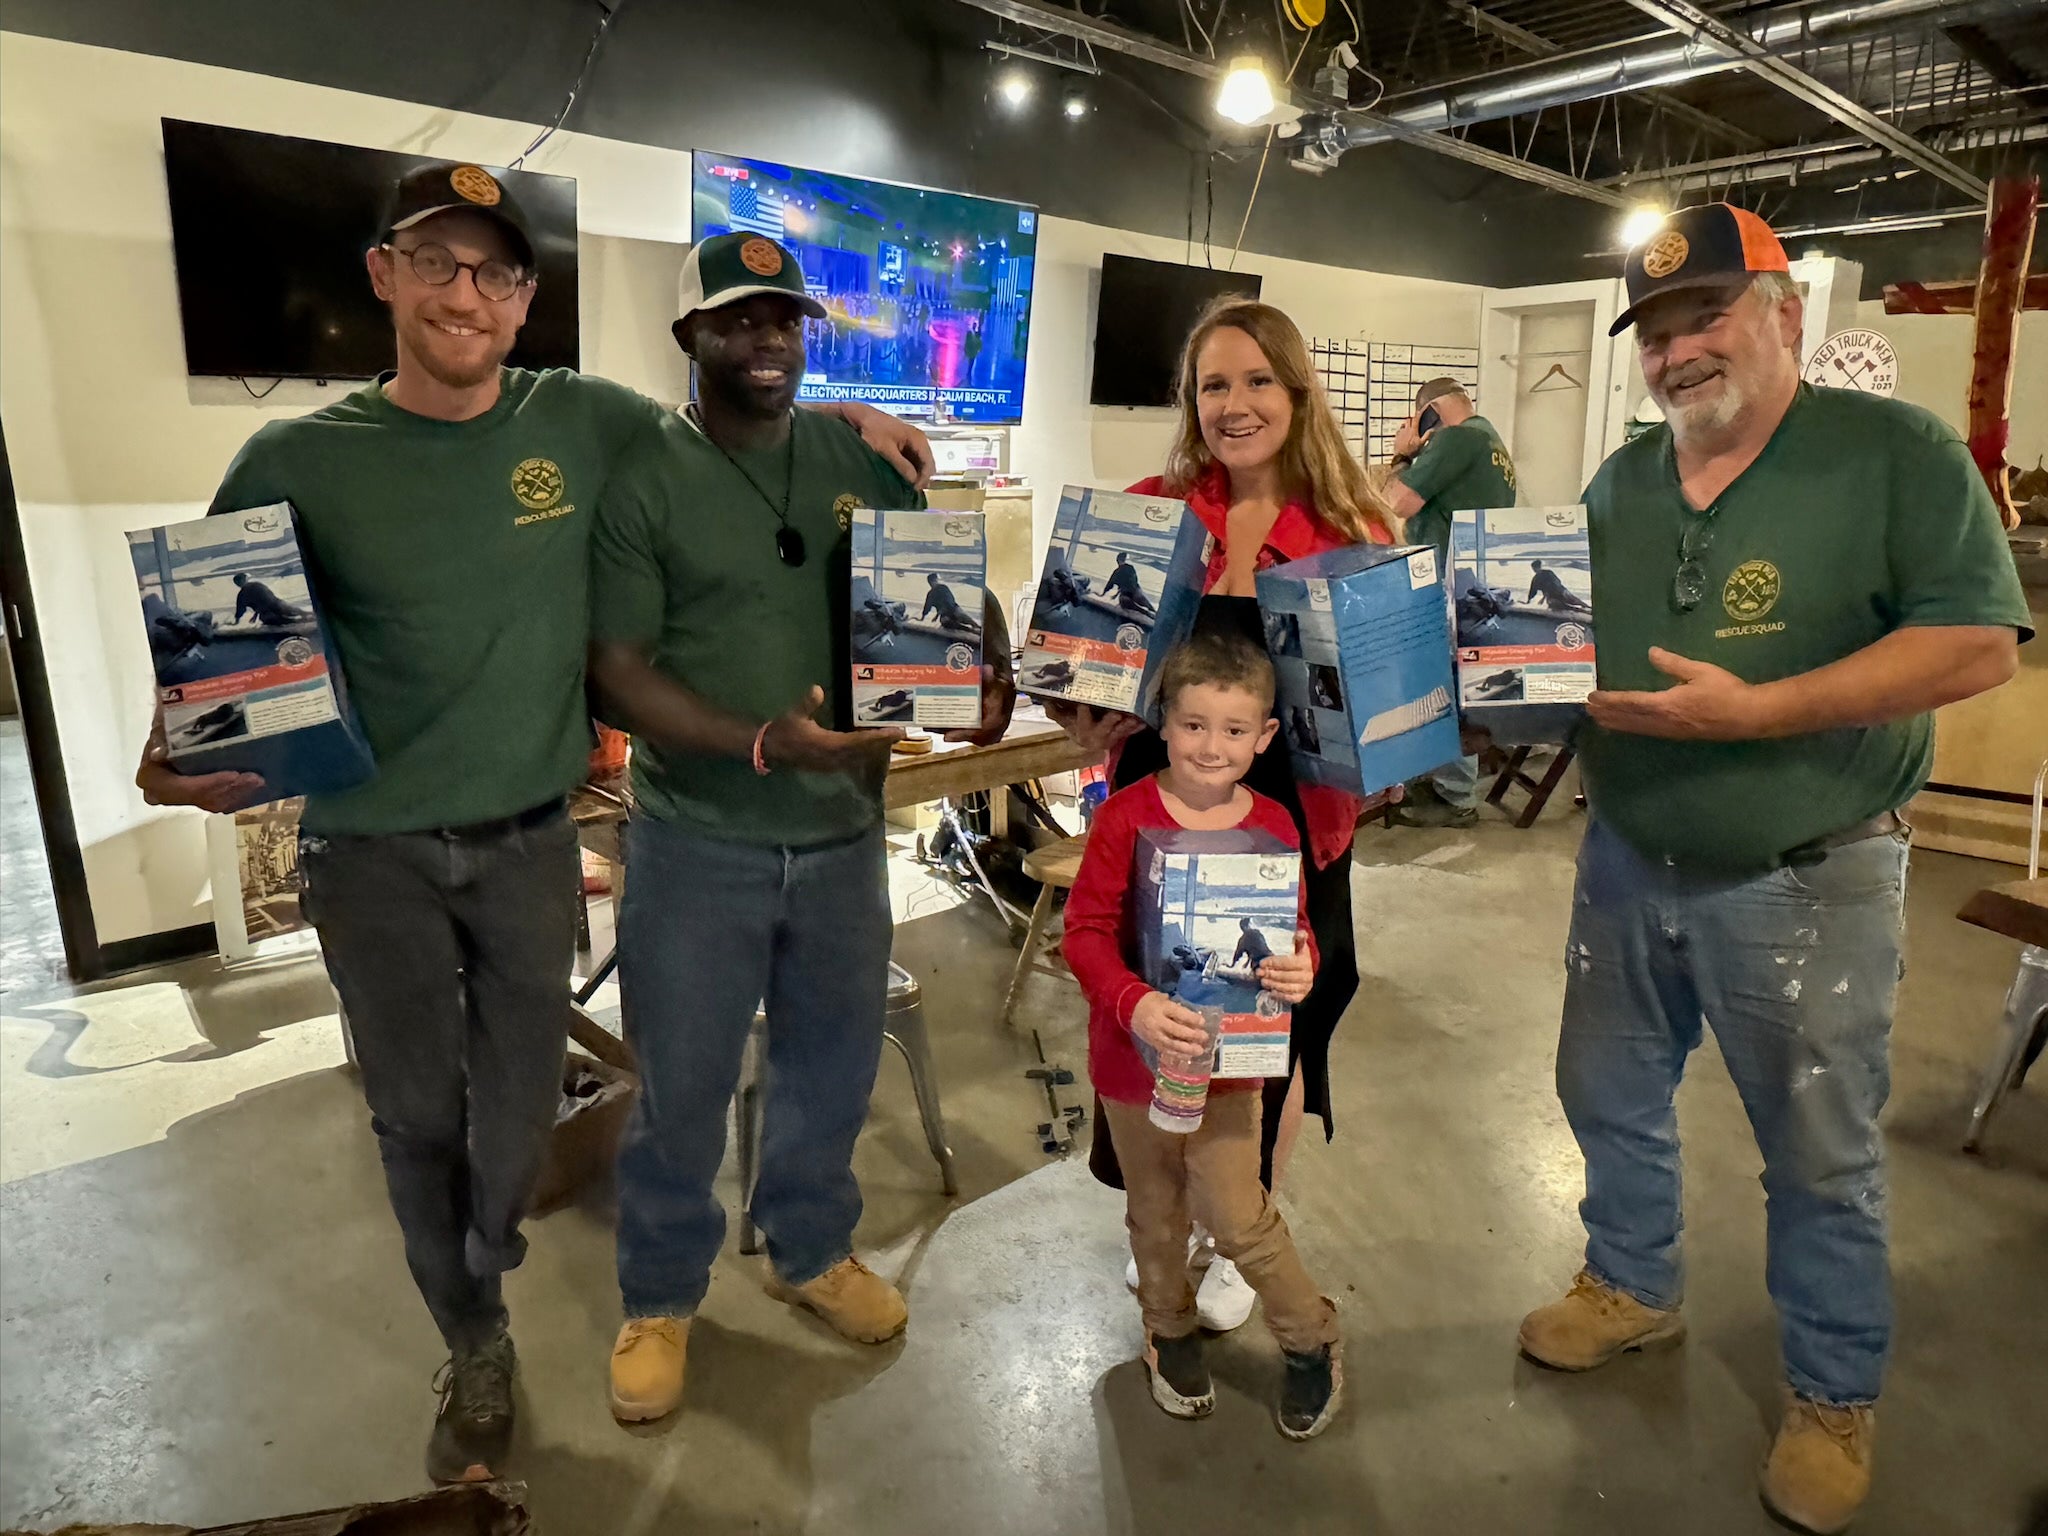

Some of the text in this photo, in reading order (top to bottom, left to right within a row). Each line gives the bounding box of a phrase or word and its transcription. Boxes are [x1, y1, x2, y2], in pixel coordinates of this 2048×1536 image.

[1814, 333, 1894, 367] RED TRUCK MEN
[800, 384, 850, 399] ELECTION
[850, 387, 928, 401] HEADQUARTERS
[964, 392, 997, 405] BEACH,
[998, 394, 1007, 404] FL
[548, 504, 576, 518] SQUAD
[1715, 621, 1786, 639] RESCUE SQUAD
